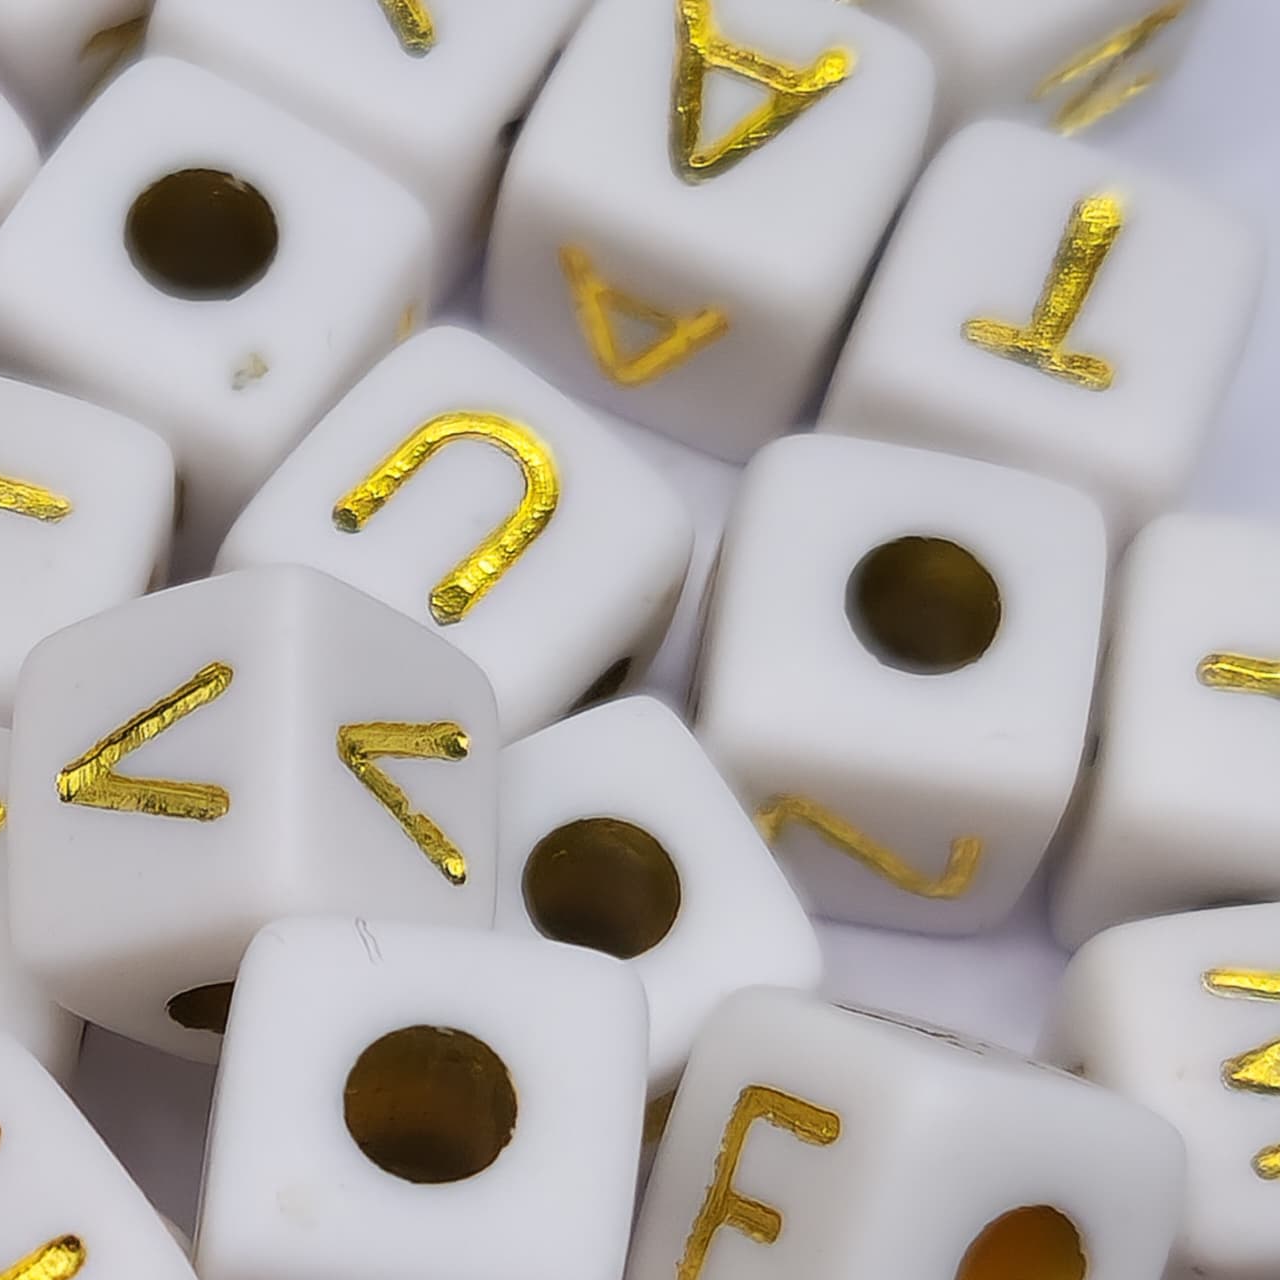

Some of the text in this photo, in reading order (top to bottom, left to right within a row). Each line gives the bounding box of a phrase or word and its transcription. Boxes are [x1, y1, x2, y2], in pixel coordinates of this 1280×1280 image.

[673, 0, 854, 178] A
[558, 244, 730, 388] A
[964, 194, 1124, 391] T
[333, 409, 560, 625] U
[57, 660, 234, 821] V
